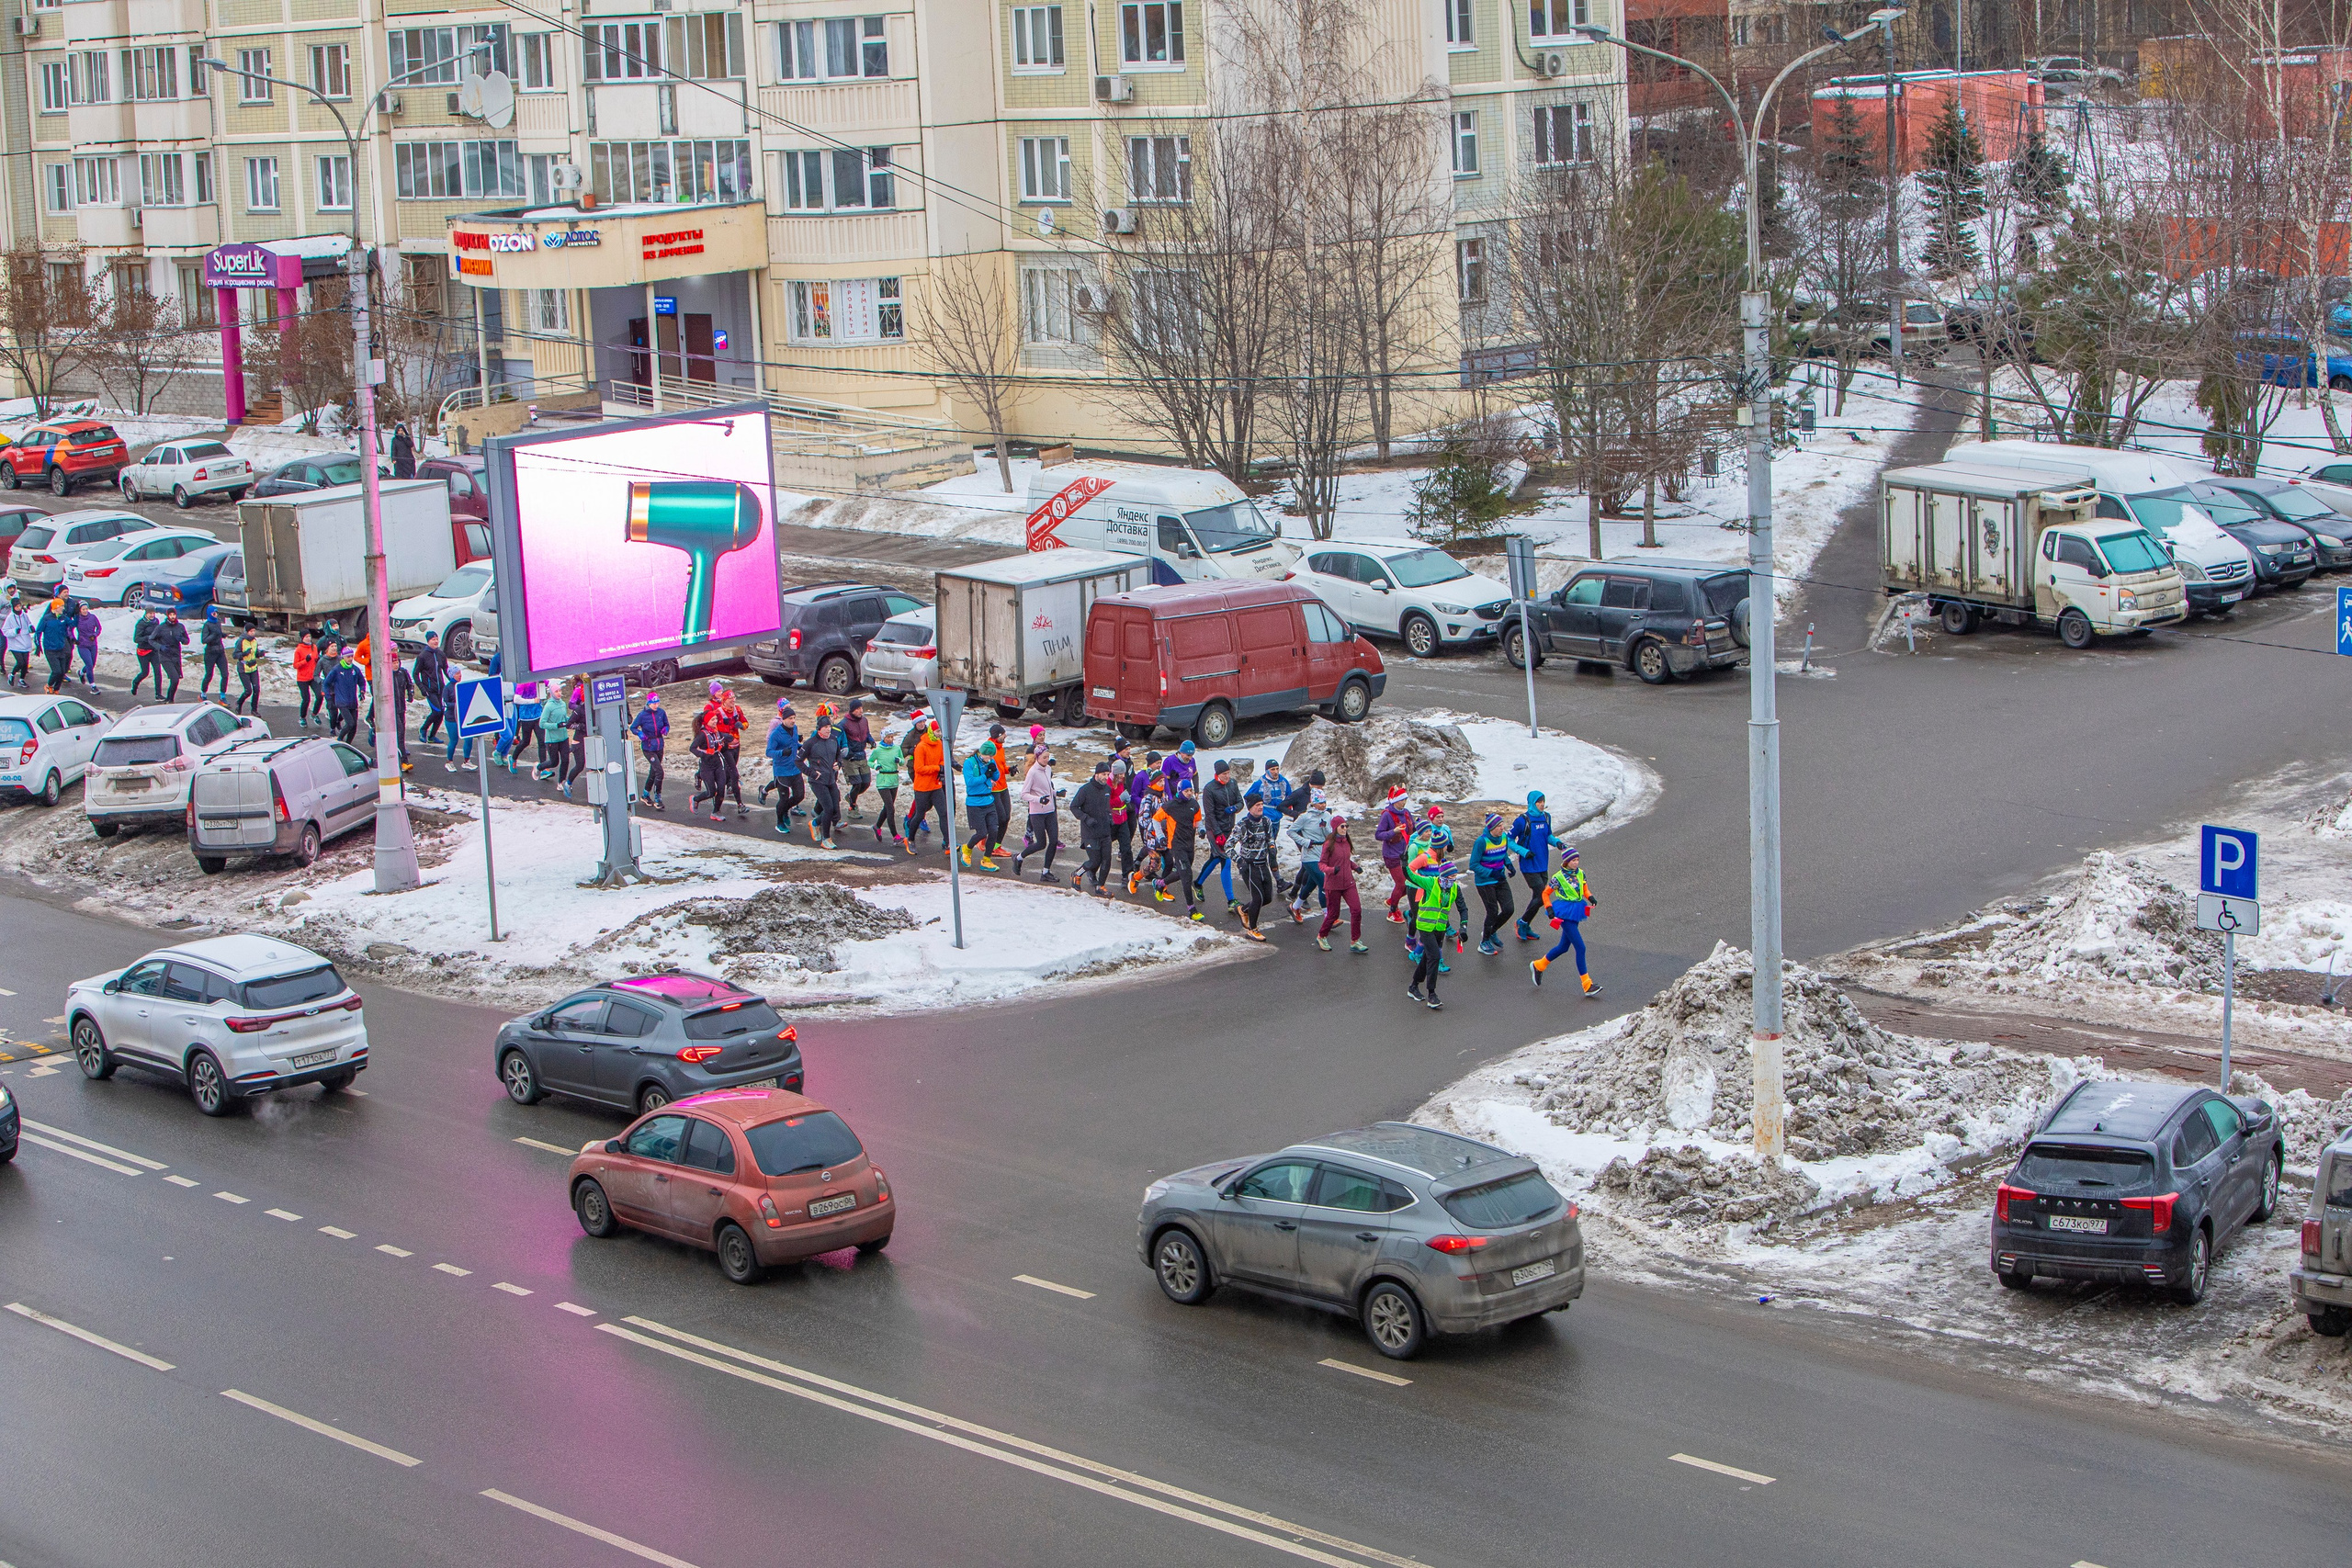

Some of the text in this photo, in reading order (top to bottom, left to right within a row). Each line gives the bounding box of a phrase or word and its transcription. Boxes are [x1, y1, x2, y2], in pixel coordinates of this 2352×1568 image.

[490, 233, 535, 252] OZON
[565, 230, 600, 243] ЛОТОС
[642, 229, 703, 245] ПРОДУКТЫ
[643, 244, 705, 259] ИЗ АРМЕНИИ
[213, 250, 266, 276] SuperLik
[846, 282, 855, 335] ПРОДУКТЫ
[1117, 507, 1149, 523] Яндекс
[1106, 519, 1148, 536] Доставка
[1254, 561, 1282, 573] Доставка
[2040, 1199, 2117, 1210] HAVAL
[2326, 1205, 2352, 1214] TANK
